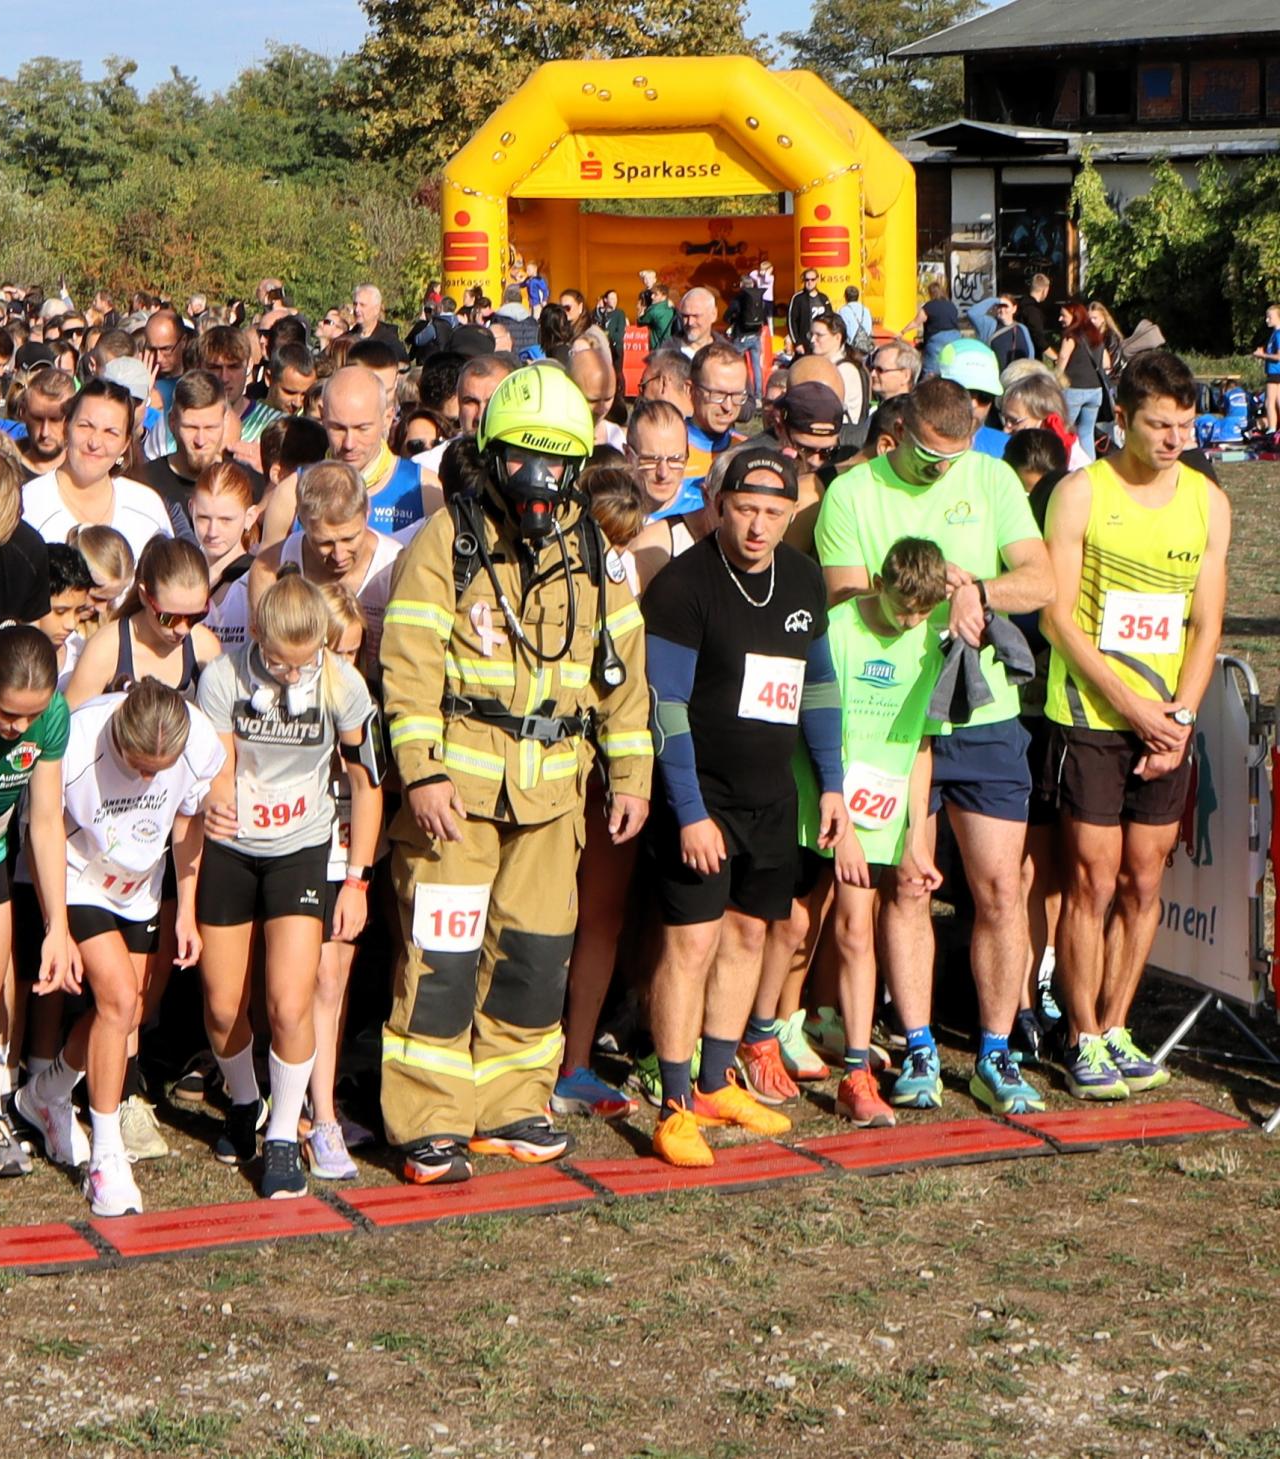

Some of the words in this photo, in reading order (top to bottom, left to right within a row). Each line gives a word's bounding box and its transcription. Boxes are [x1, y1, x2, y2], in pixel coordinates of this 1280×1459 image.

[613, 161, 721, 183] Sparkasse
[445, 277, 490, 289] parkasse
[819, 274, 851, 283] kasse
[521, 432, 572, 452] Bullard
[374, 506, 413, 519] wobau
[1118, 614, 1169, 640] 354
[758, 682, 798, 711] 463
[236, 717, 321, 739] NOLIMITS
[253, 796, 307, 829] 394
[849, 788, 897, 820] 620
[430, 909, 481, 938] 167
